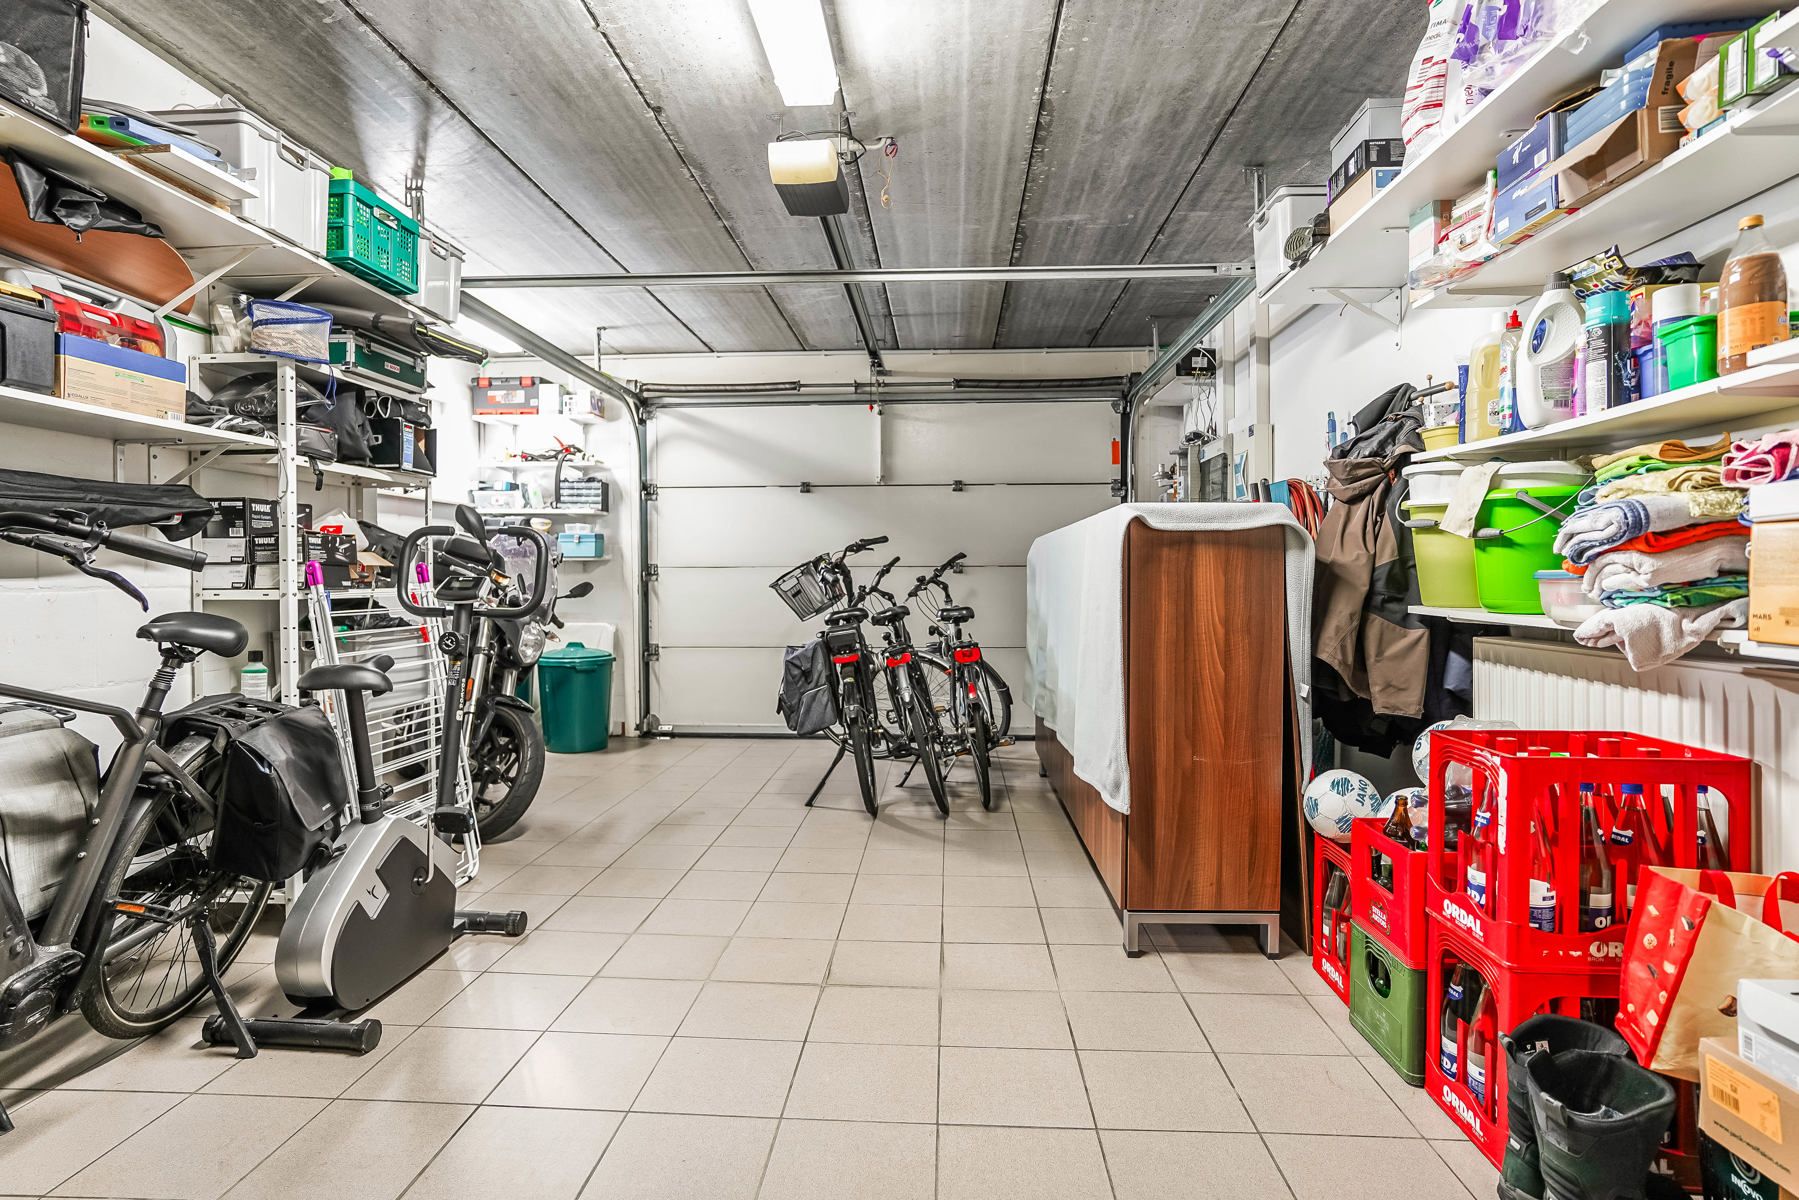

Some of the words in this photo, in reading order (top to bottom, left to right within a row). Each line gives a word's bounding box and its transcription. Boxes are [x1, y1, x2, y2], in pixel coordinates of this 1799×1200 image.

[1661, 61, 1675, 95] fragile
[251, 503, 272, 513] THULE
[254, 536, 276, 545] THULE
[1355, 779, 1370, 807] JAKO
[1371, 905, 1387, 922] STELLA
[1443, 898, 1484, 937] ORDAL
[1321, 957, 1344, 989] ORDAL
[1442, 1084, 1484, 1137] ORDAL
